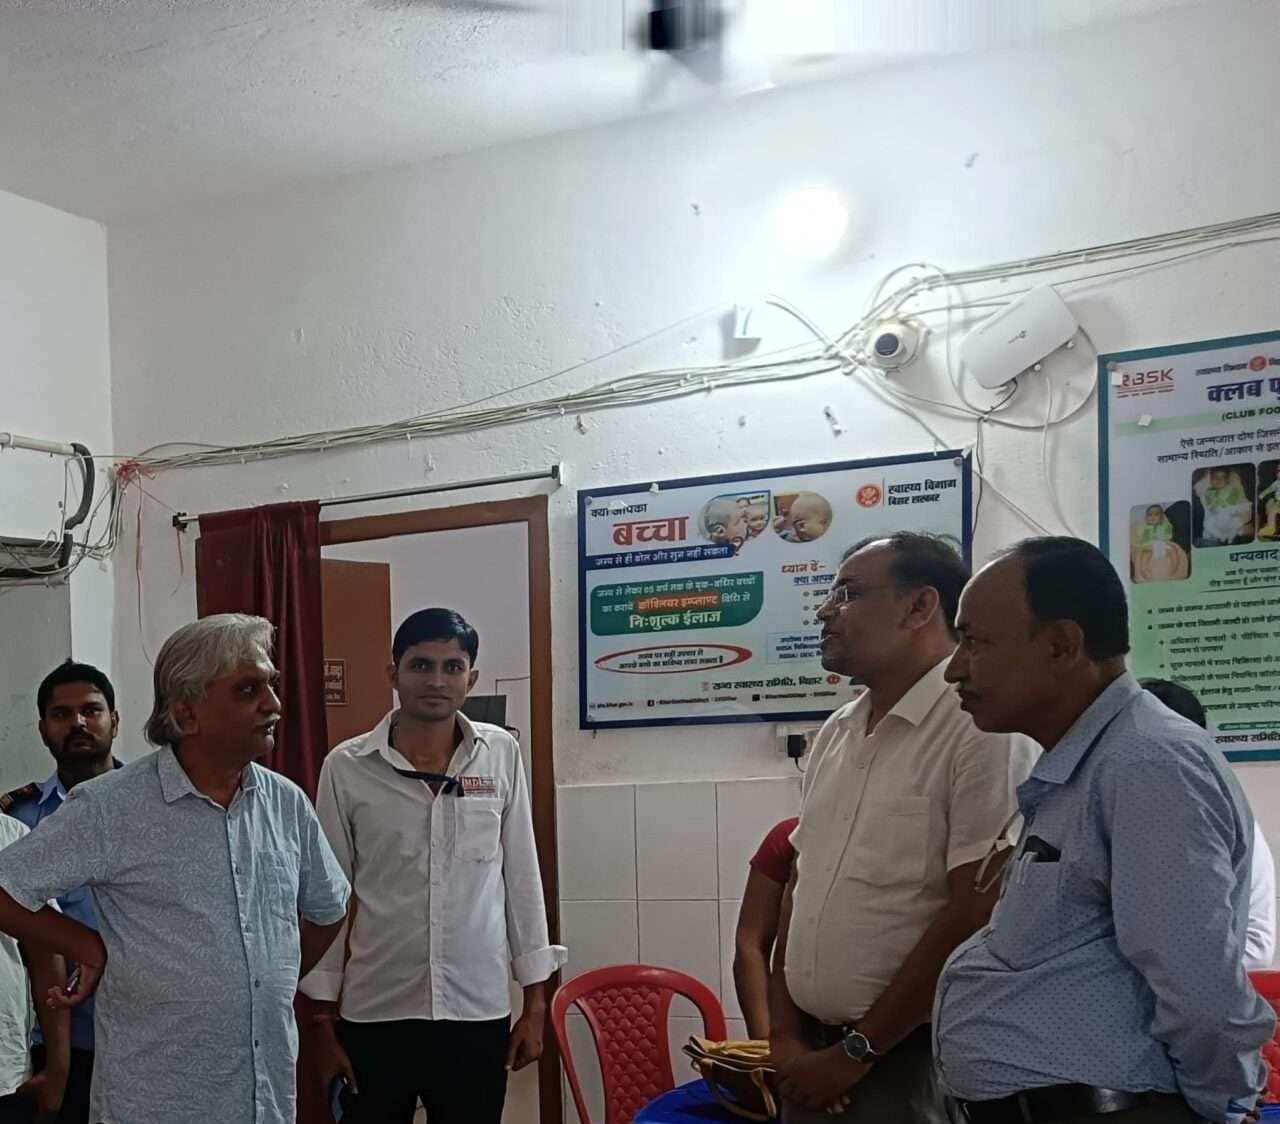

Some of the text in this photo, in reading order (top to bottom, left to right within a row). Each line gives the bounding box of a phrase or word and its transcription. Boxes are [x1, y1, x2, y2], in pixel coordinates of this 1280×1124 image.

[1206, 378, 1264, 404] क्लब
[612, 516, 690, 546] बच्चा
[683, 609, 721, 626] ईलाज
